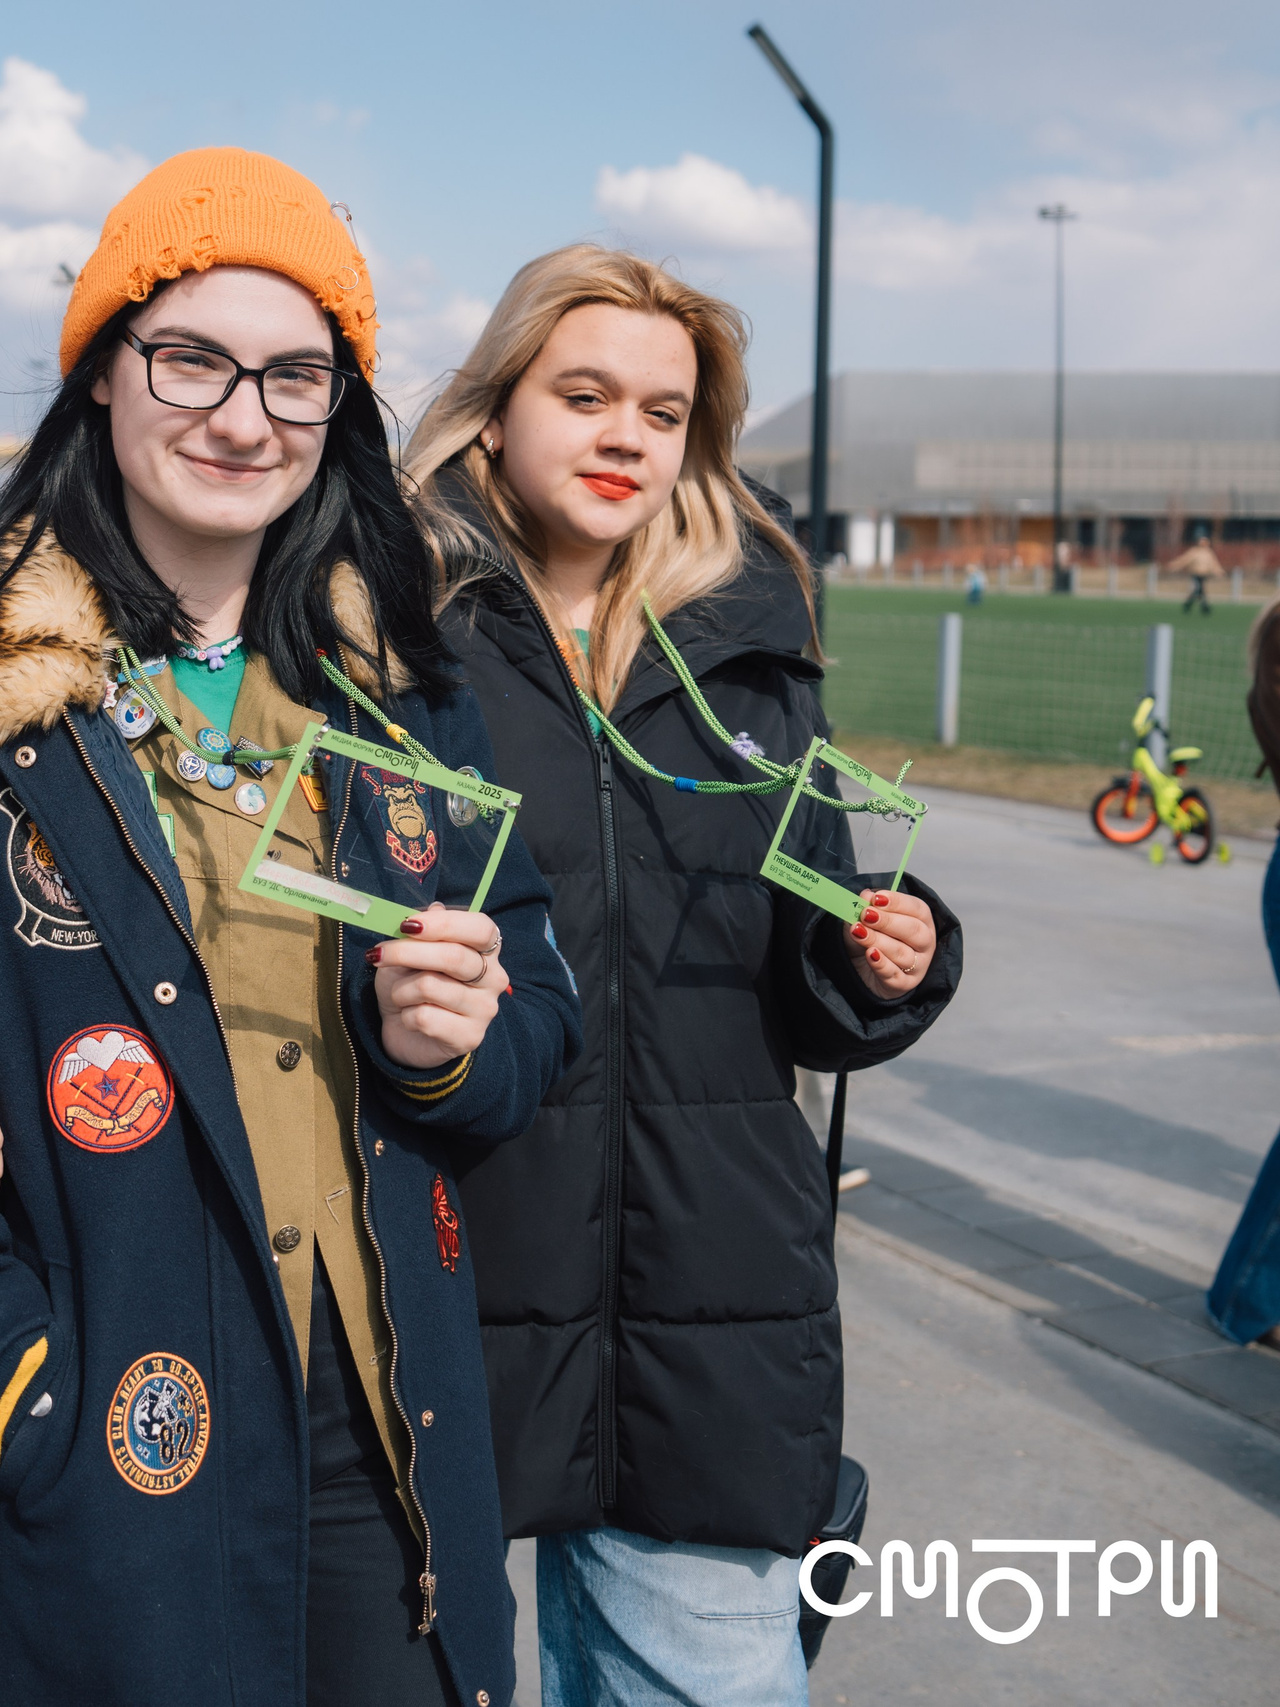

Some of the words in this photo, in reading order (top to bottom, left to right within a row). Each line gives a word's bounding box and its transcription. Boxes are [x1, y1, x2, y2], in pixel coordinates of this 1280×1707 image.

[331, 734, 352, 747] МЕДИА
[352, 742, 375, 754] ФОРУМ
[374, 748, 420, 778] СМОТРИ
[847, 760, 873, 787] СМОТРИ
[456, 780, 477, 792] КАЗАНЬ
[477, 784, 503, 800] 2025
[901, 795, 917, 810] 2025
[773, 853, 802, 875] ГНЕУШЕВА
[800, 869, 820, 885] ДАРЬЯ
[252, 876, 267, 887] БУЗ
[282, 885, 332, 907] "Орловчанка"
[159, 1417, 193, 1466] 82
